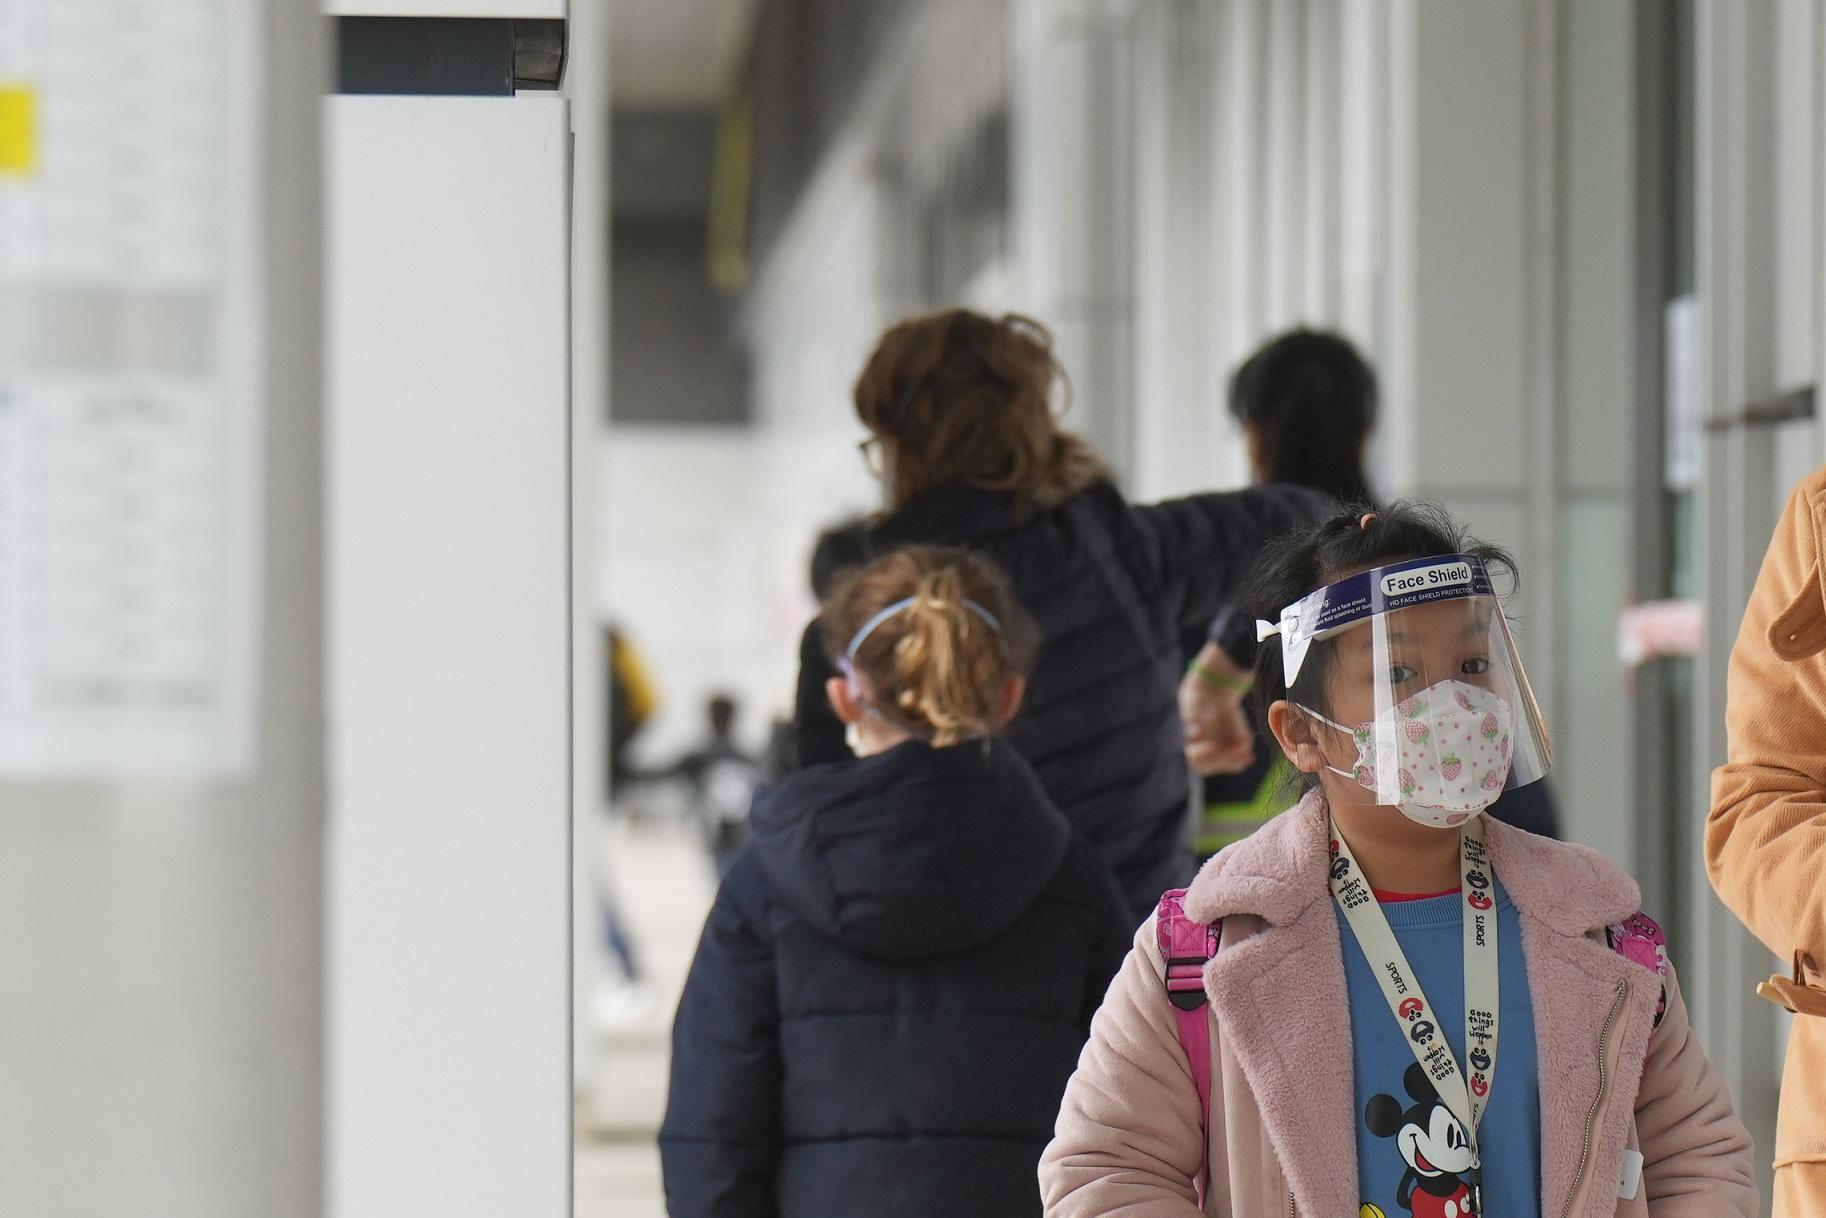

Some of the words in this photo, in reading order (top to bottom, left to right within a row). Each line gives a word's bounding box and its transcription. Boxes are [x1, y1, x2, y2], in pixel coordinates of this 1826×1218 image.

[1387, 575, 1424, 592] Face
[1428, 566, 1468, 583] Shield
[1341, 601, 1351, 609] face
[1400, 595, 1417, 604] FACE
[1418, 591, 1440, 601] SHIELD
[1476, 915, 1485, 948] SPORTS
[1385, 961, 1408, 994] SPORTS
[1468, 1016, 1494, 1028] things
